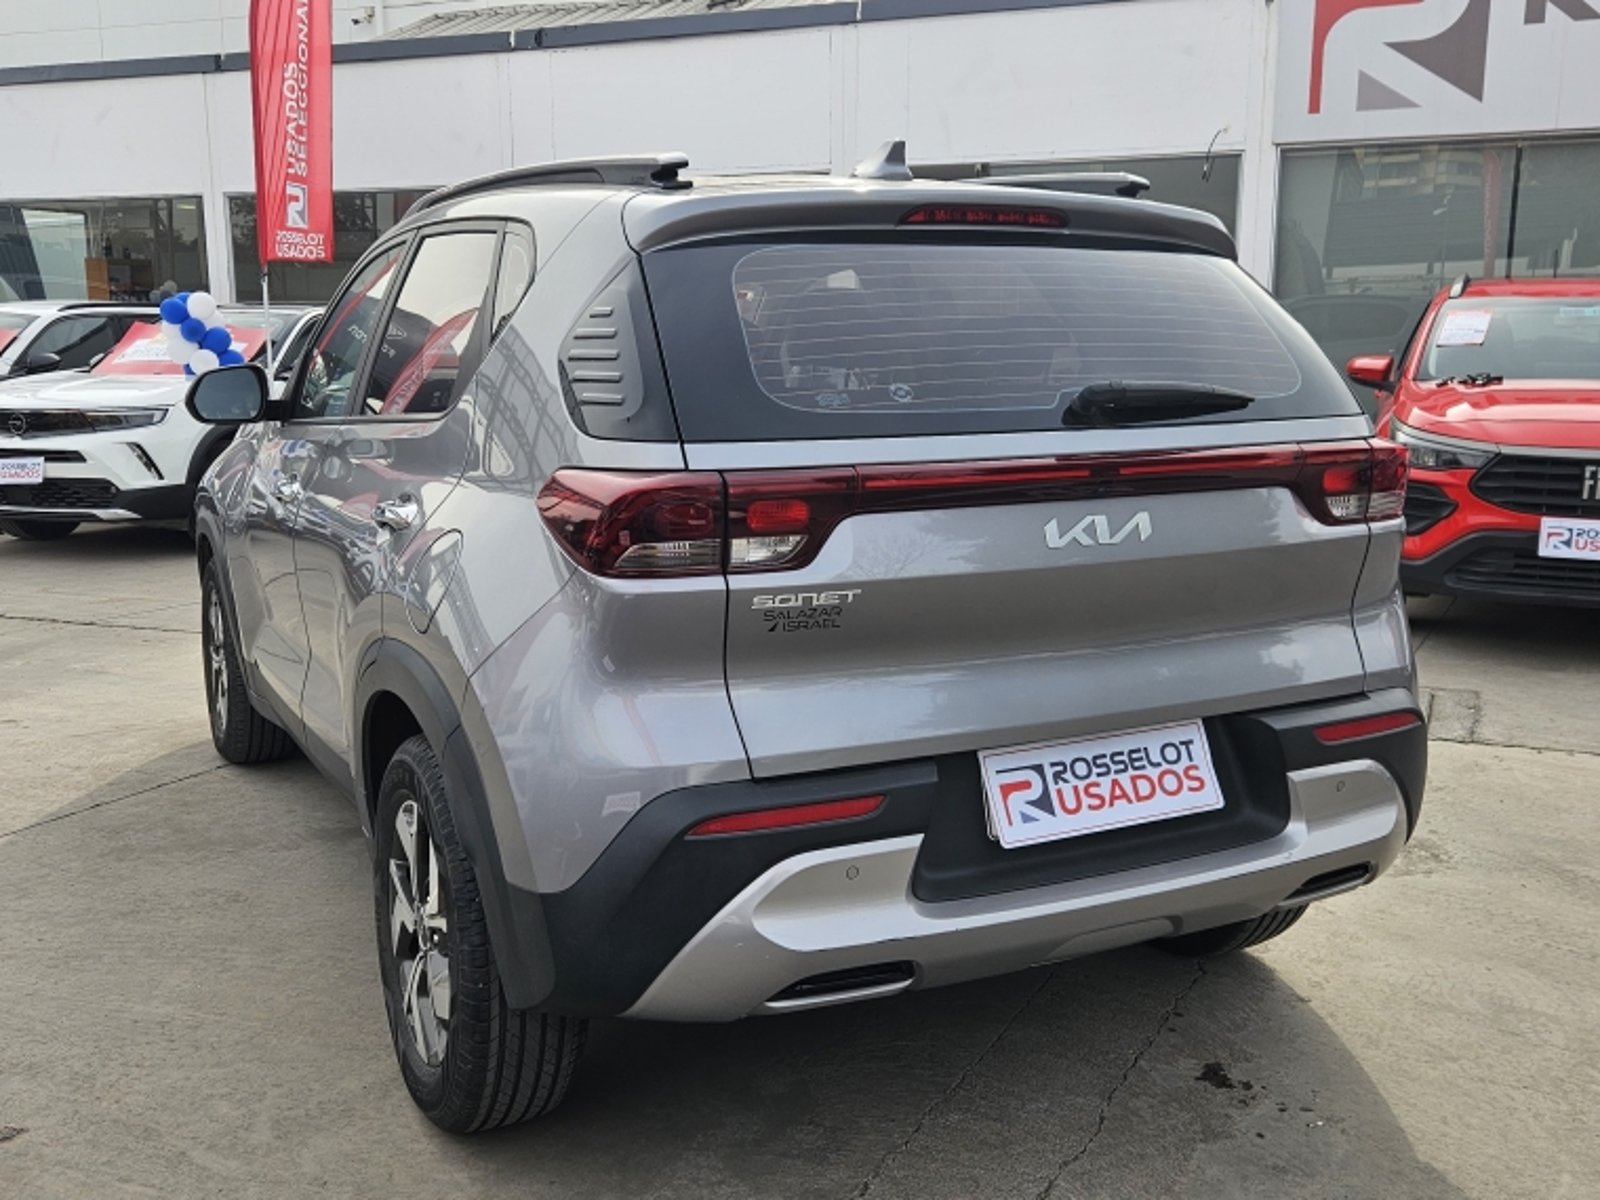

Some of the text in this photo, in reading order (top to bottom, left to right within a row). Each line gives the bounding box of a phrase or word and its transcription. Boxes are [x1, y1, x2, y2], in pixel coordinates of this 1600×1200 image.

[296, 0, 309, 177] SELECCIONA
[283, 61, 299, 175] USADOS
[275, 243, 326, 260] USADOS
[1044, 510, 1152, 549] KIA
[763, 606, 843, 622] SALAZAR
[782, 619, 841, 632] ISRAEL
[1050, 739, 1194, 786] ROSSELOT
[1056, 764, 1206, 816] USADOS
